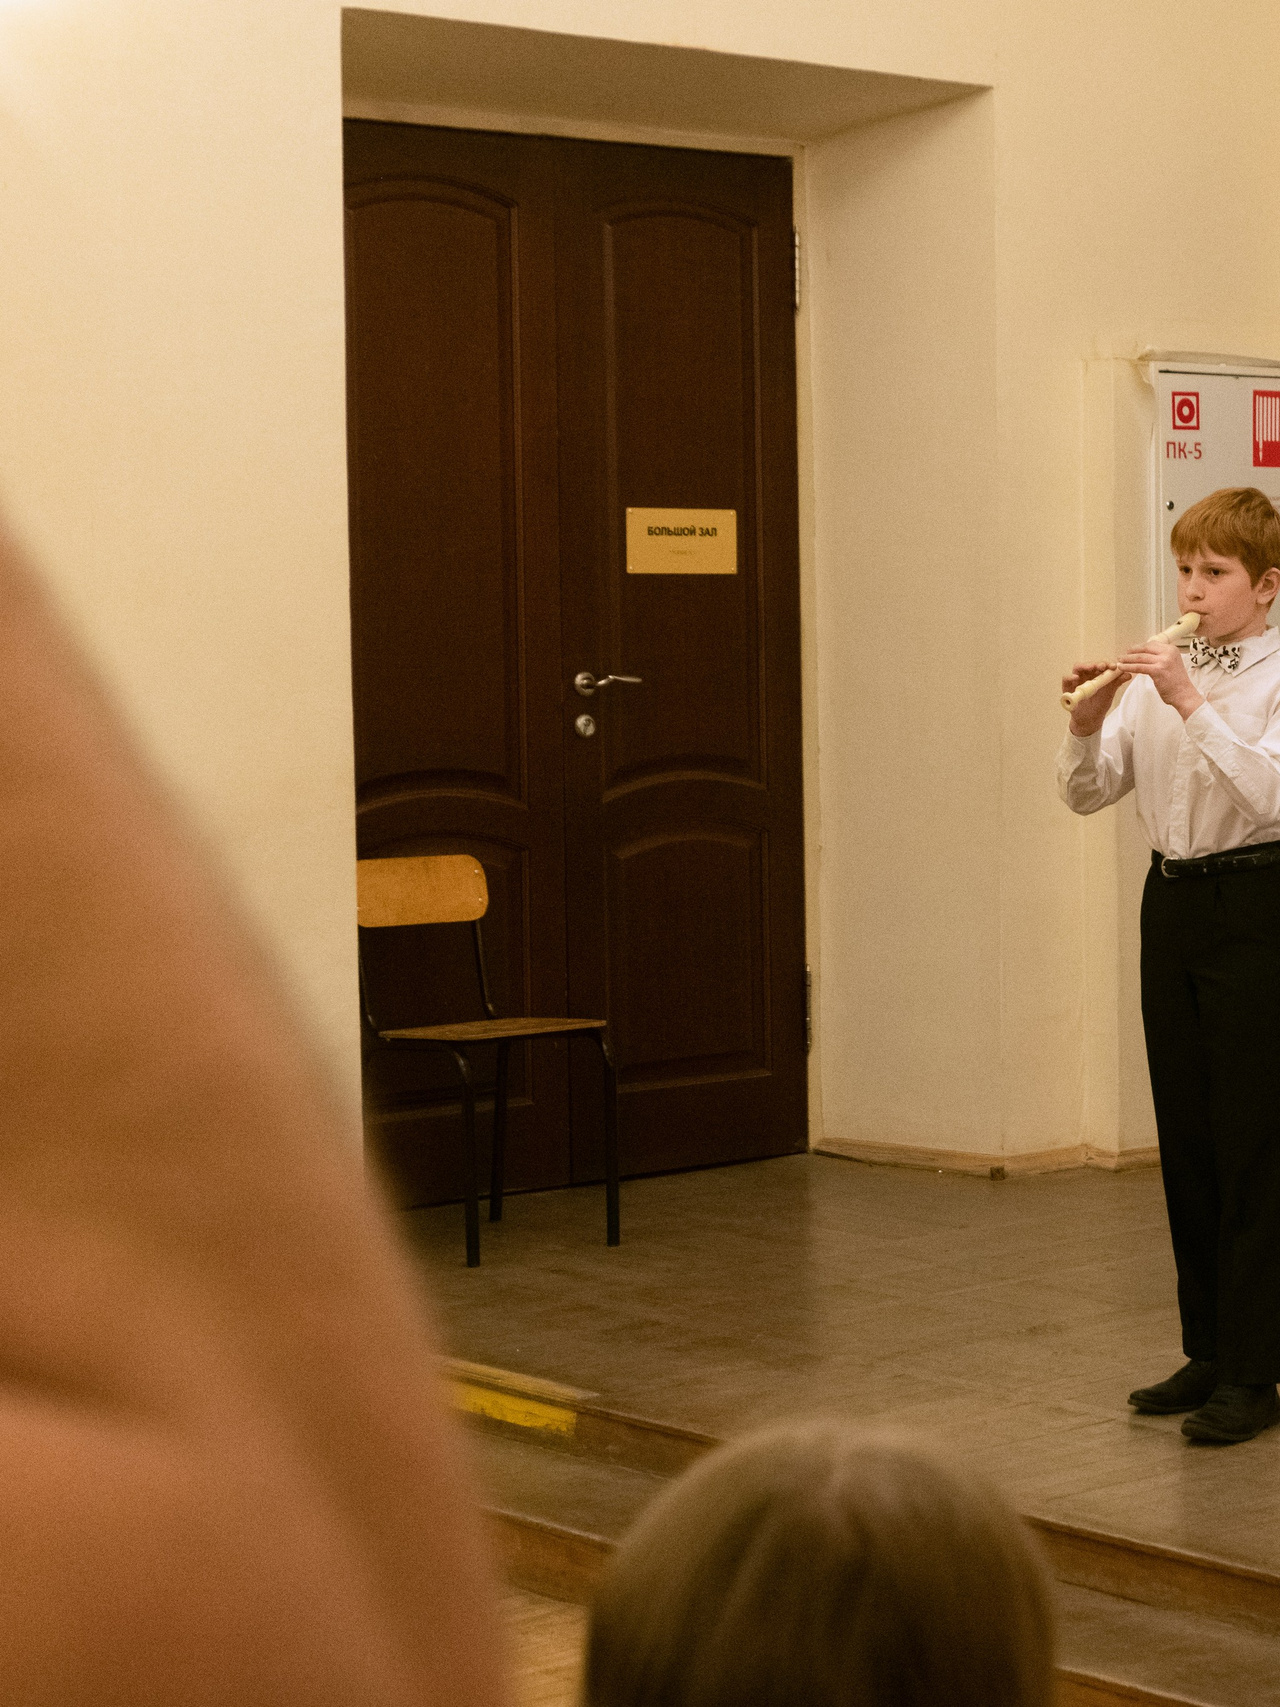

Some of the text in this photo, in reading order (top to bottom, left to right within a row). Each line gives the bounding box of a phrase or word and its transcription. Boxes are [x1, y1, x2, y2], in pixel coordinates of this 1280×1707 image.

[1166, 441, 1202, 460] ПК-5
[647, 524, 718, 537] БОЛЬШОЙ ЗАЛ
